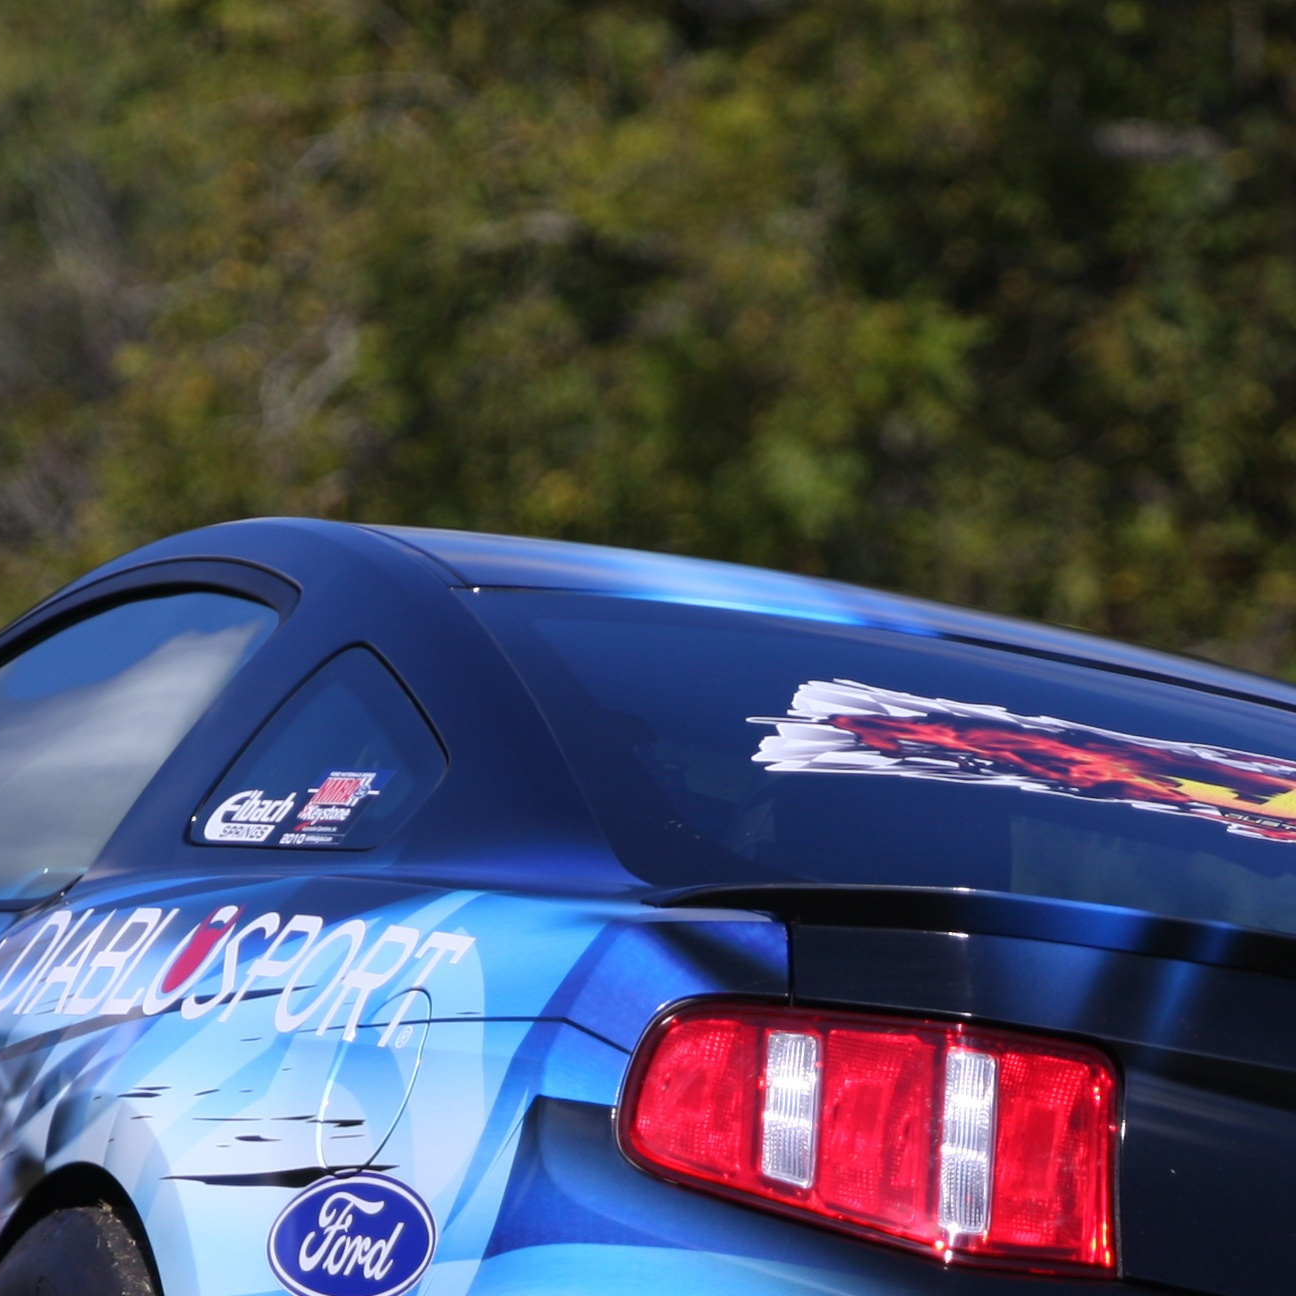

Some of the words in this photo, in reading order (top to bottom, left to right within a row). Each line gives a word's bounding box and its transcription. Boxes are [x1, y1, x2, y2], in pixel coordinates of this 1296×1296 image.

[204, 790, 297, 841] Eibach
[304, 804, 351, 825] Keystone
[218, 825, 268, 839] SPRINGS
[279, 833, 306, 845] 2010
[299, 1191, 405, 1280] Ford
